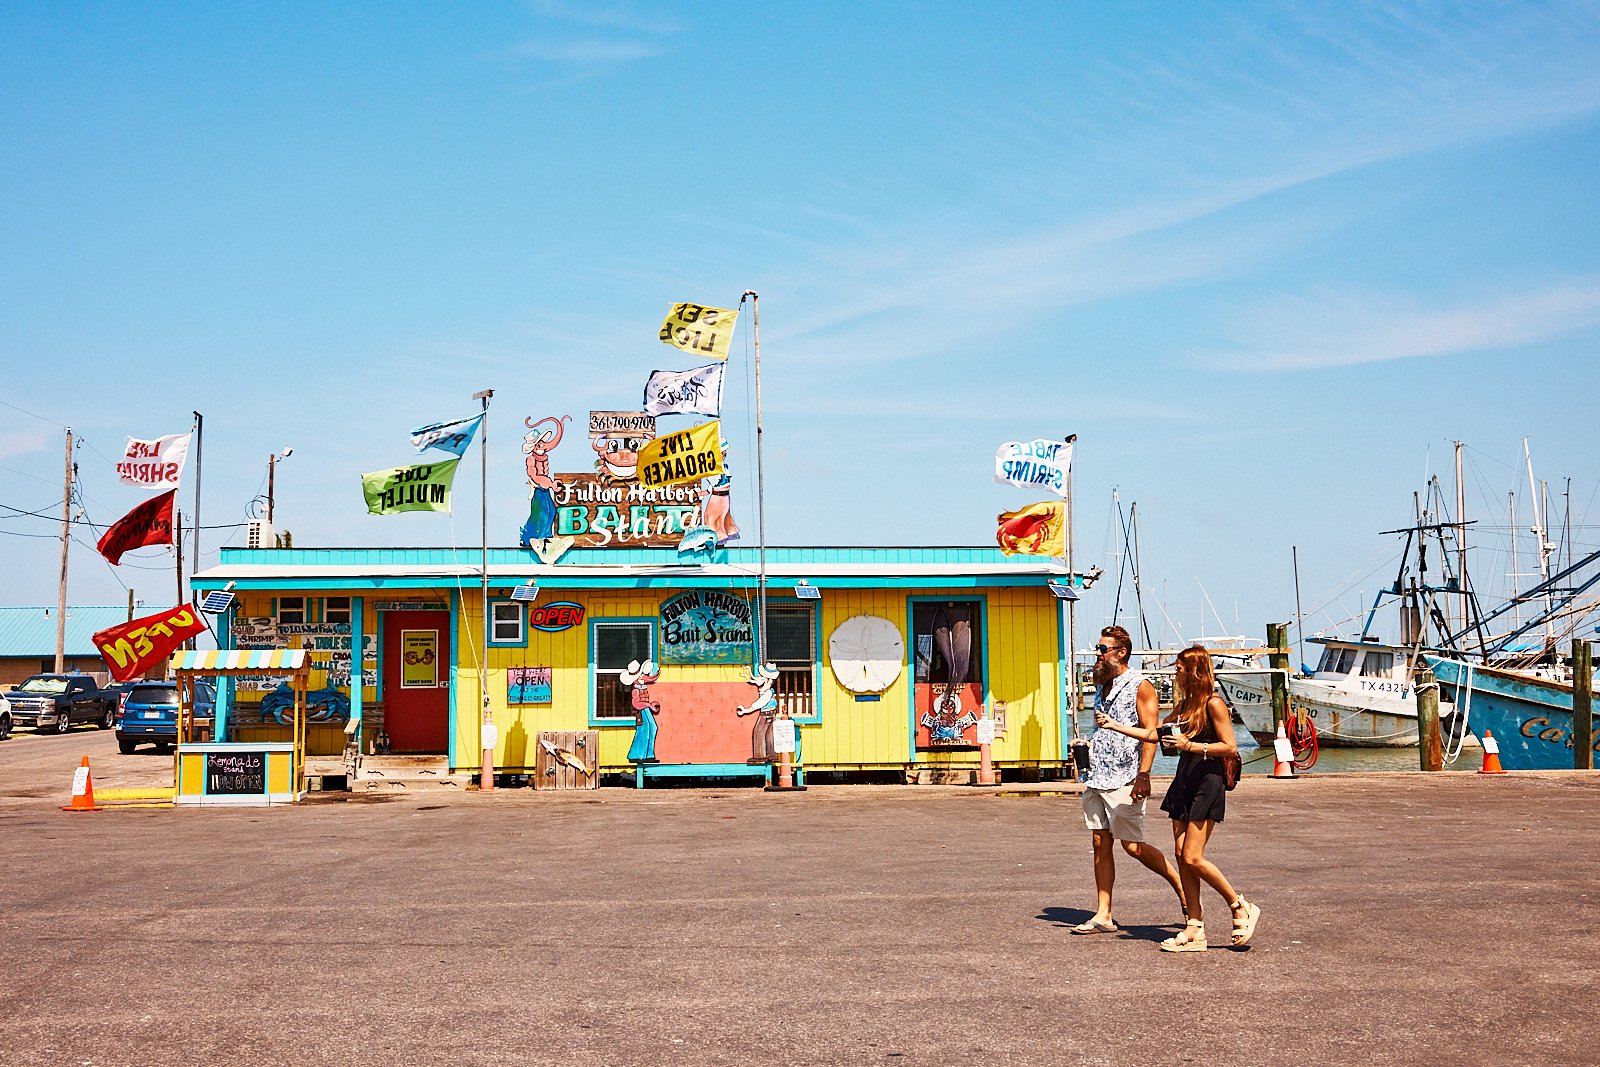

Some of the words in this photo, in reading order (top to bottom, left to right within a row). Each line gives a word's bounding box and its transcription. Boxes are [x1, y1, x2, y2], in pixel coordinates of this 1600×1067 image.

[556, 481, 622, 504] Fulton
[557, 505, 694, 536] BAIT
[585, 505, 701, 546] Stand
[531, 607, 584, 626] OPEN
[661, 591, 701, 623] FULTON
[704, 592, 752, 625] HARBOR
[239, 635, 274, 643] SHRIMP
[661, 619, 701, 645] Bait
[704, 619, 752, 643] Stand
[314, 636, 340, 649] TABLE
[516, 676, 544, 685] OPEN
[1360, 681, 1376, 690] TX
[1236, 689, 1263, 704] CAPT
